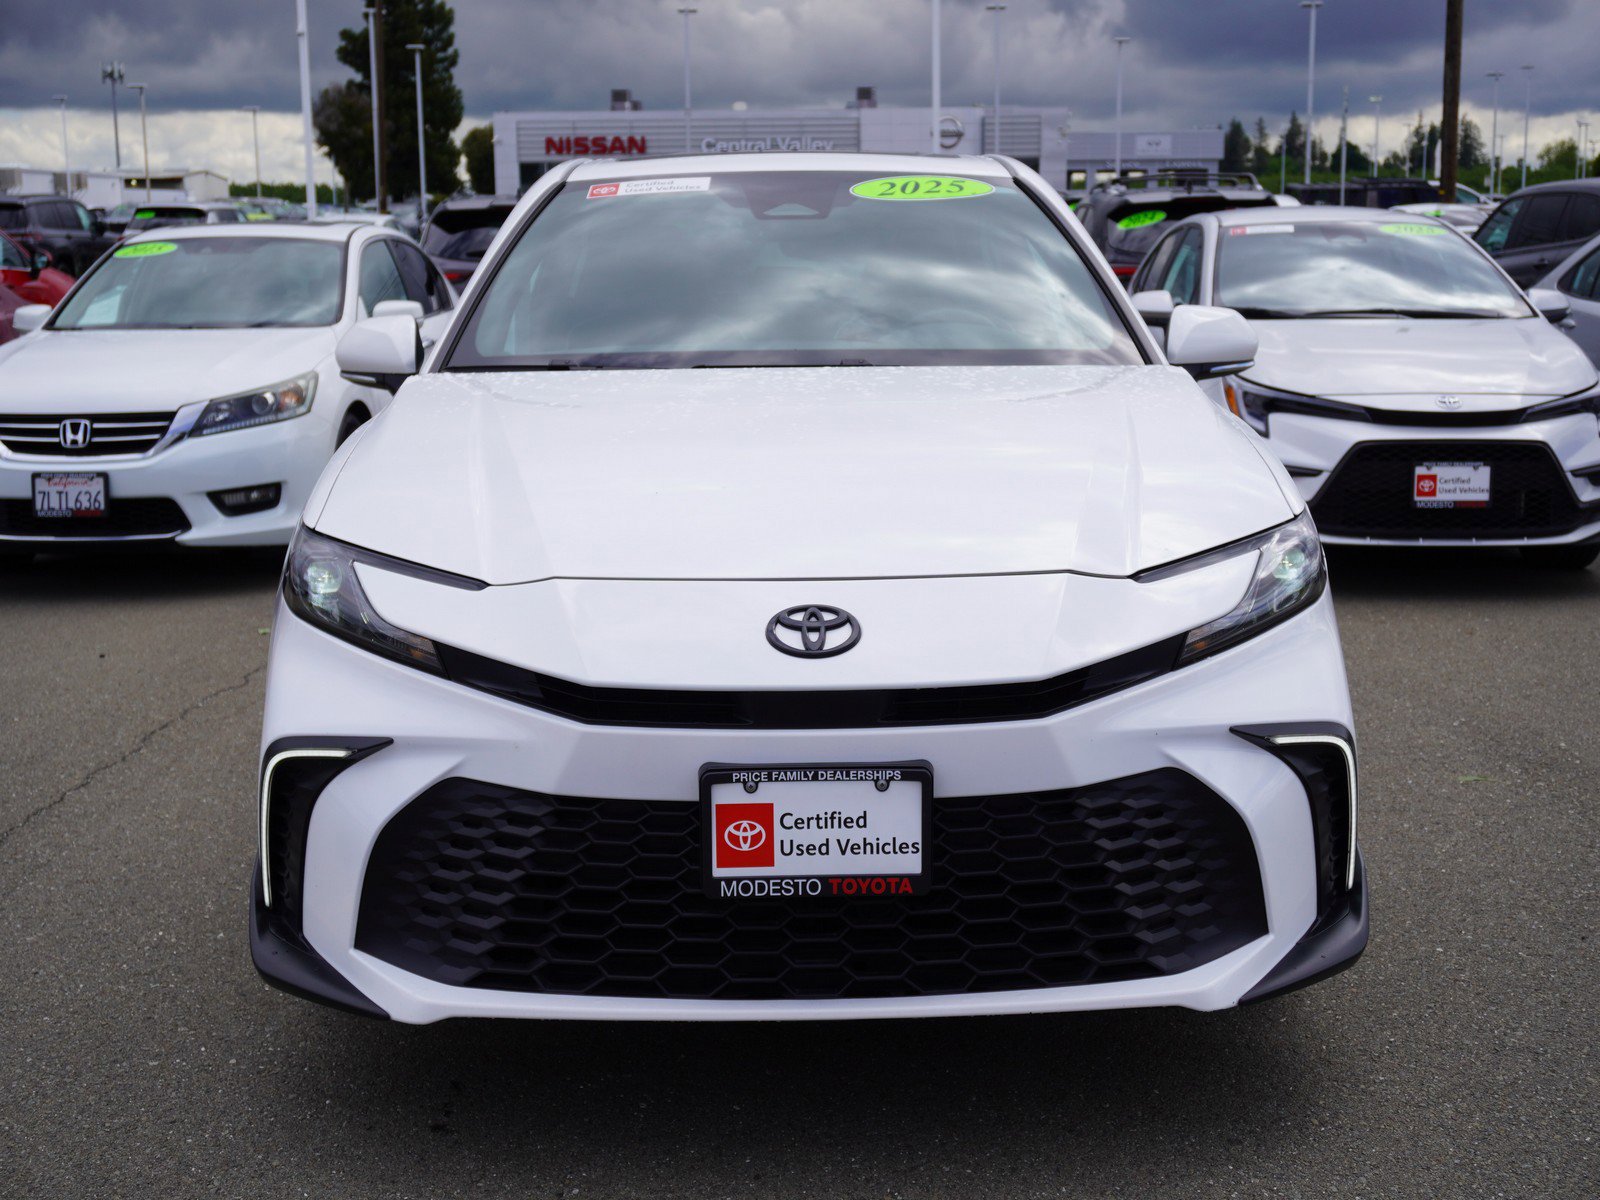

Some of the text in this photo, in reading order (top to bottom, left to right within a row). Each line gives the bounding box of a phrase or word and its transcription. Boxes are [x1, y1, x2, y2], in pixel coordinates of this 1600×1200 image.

[545, 136, 646, 154] NISSAN
[700, 136, 834, 153] Central Valley
[626, 180, 674, 188] Certified
[878, 180, 965, 196] 2025
[38, 490, 101, 511] 7LTL636
[732, 770, 902, 782] PRICE FAMILY DEALERSHIPS
[779, 811, 867, 830] Certified
[779, 837, 920, 857] Used Vehicles
[721, 878, 913, 897] MODESTO TOYOTA
